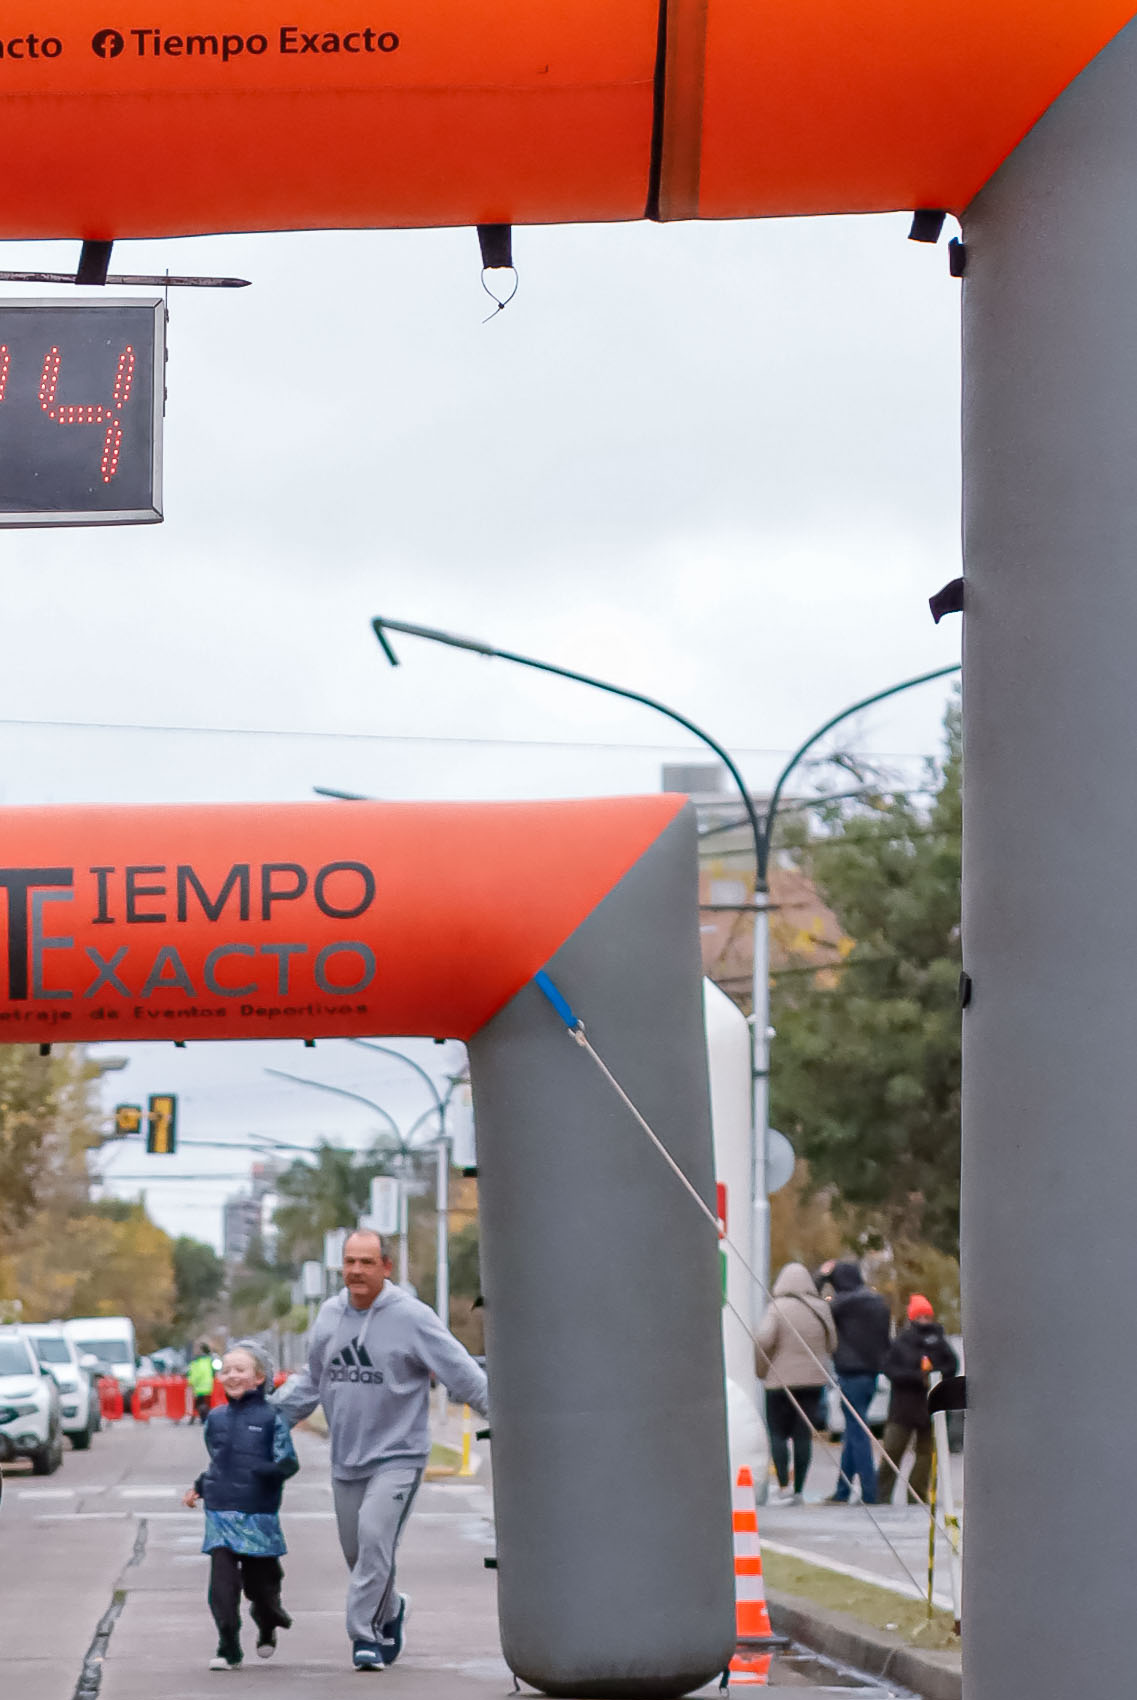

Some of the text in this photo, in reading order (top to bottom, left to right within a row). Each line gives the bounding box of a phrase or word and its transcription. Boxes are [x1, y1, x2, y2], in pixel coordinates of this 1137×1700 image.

[130, 26, 400, 63] Tiempo Exacto
[88, 1006, 120, 1022] de
[133, 1004, 227, 1020] Eventos
[240, 1002, 369, 1020] Deportivos
